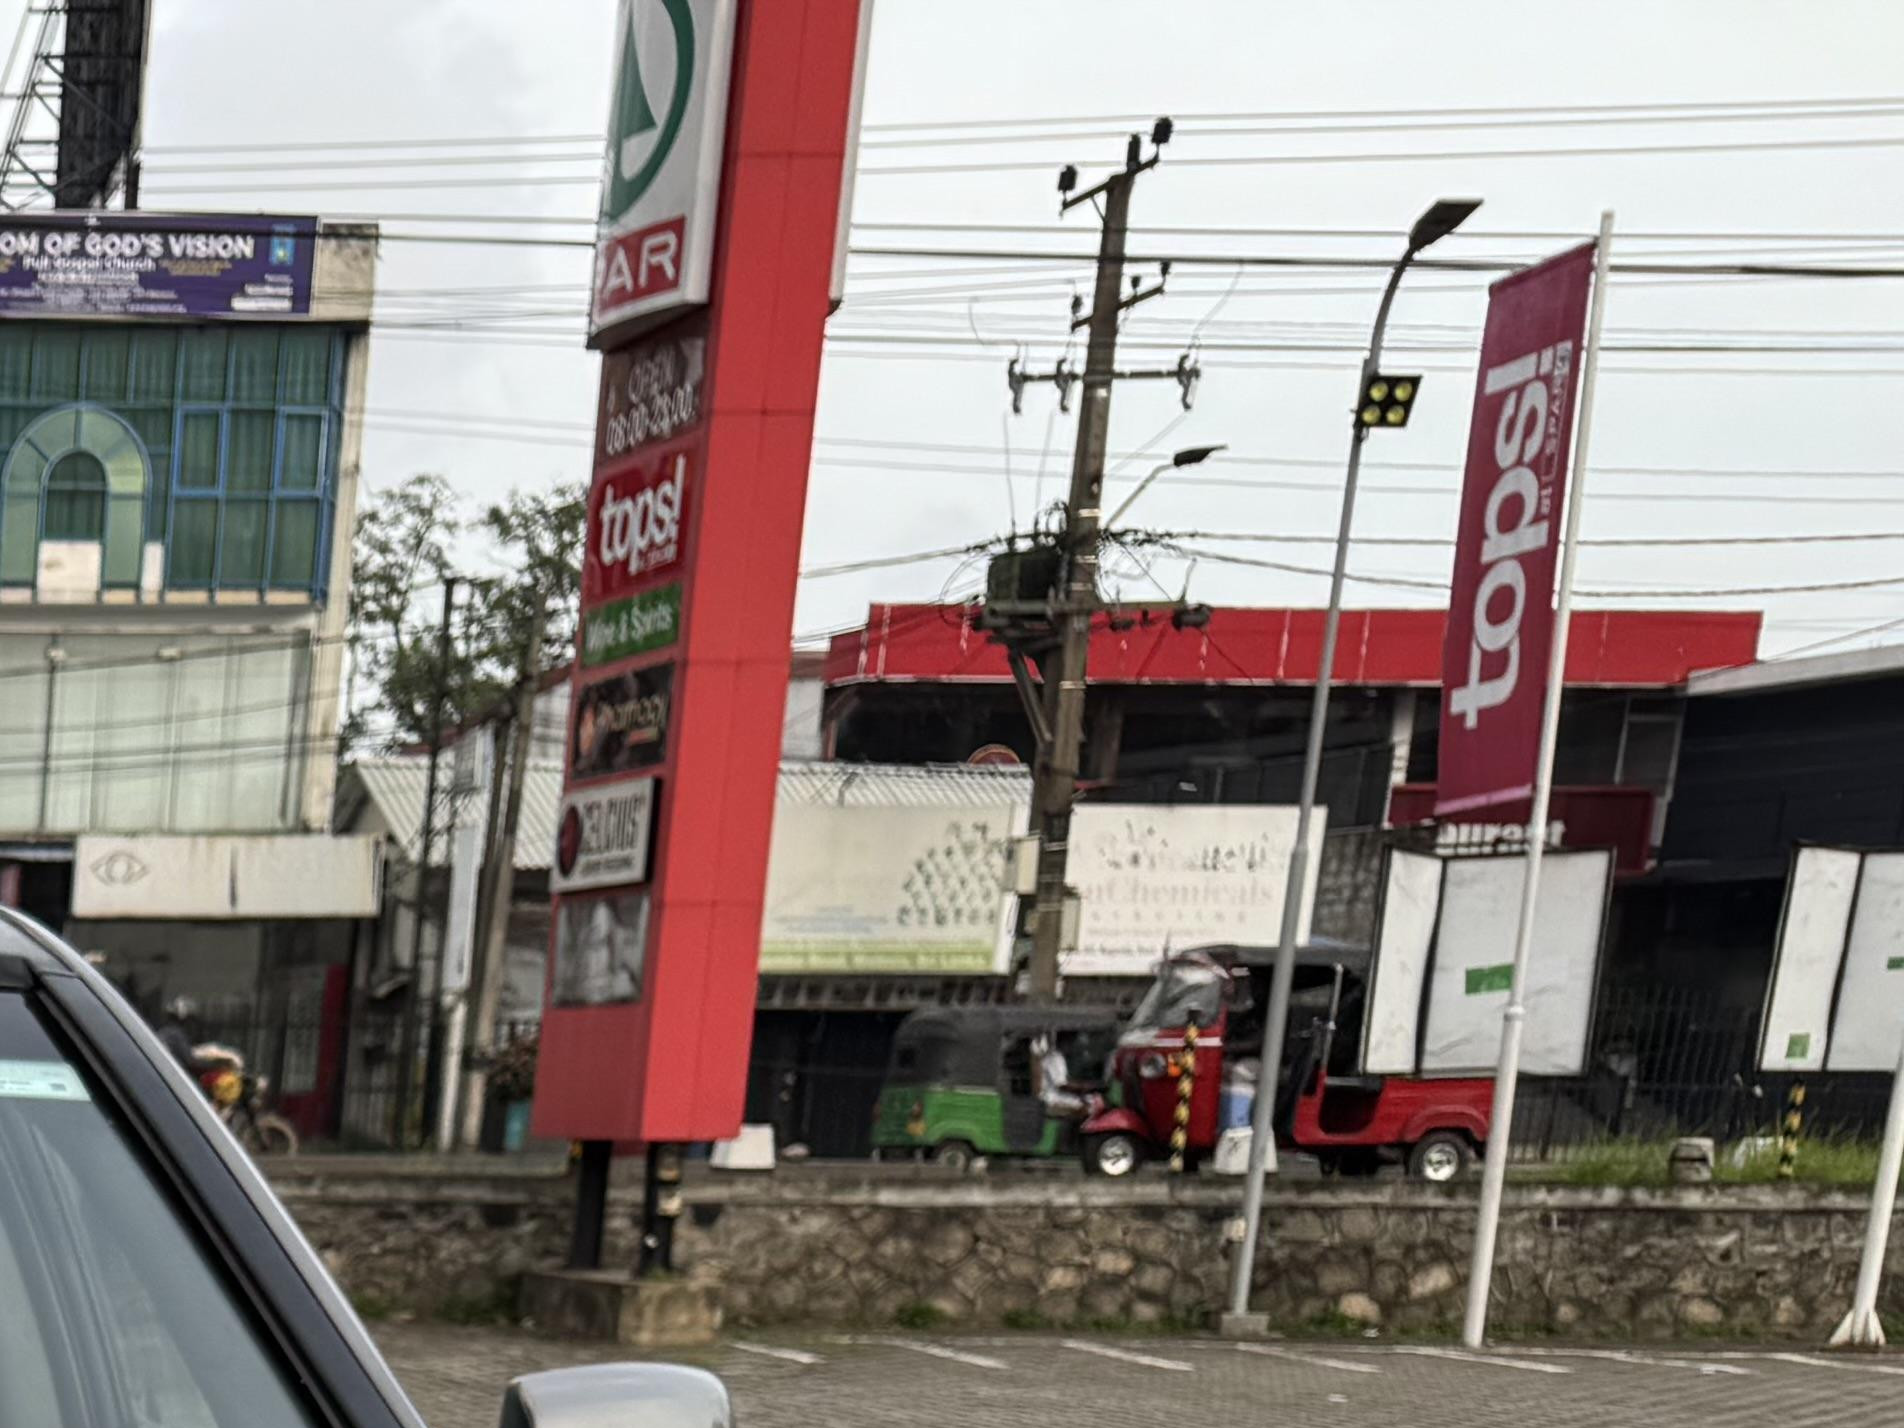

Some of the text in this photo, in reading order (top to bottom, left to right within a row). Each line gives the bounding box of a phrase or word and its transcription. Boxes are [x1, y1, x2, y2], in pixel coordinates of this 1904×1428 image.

[44, 232, 81, 256] OF
[85, 232, 164, 257] GOD'S
[168, 234, 255, 259] VISION
[599, 453, 687, 577] tops!
[1450, 346, 1555, 730] tops!
